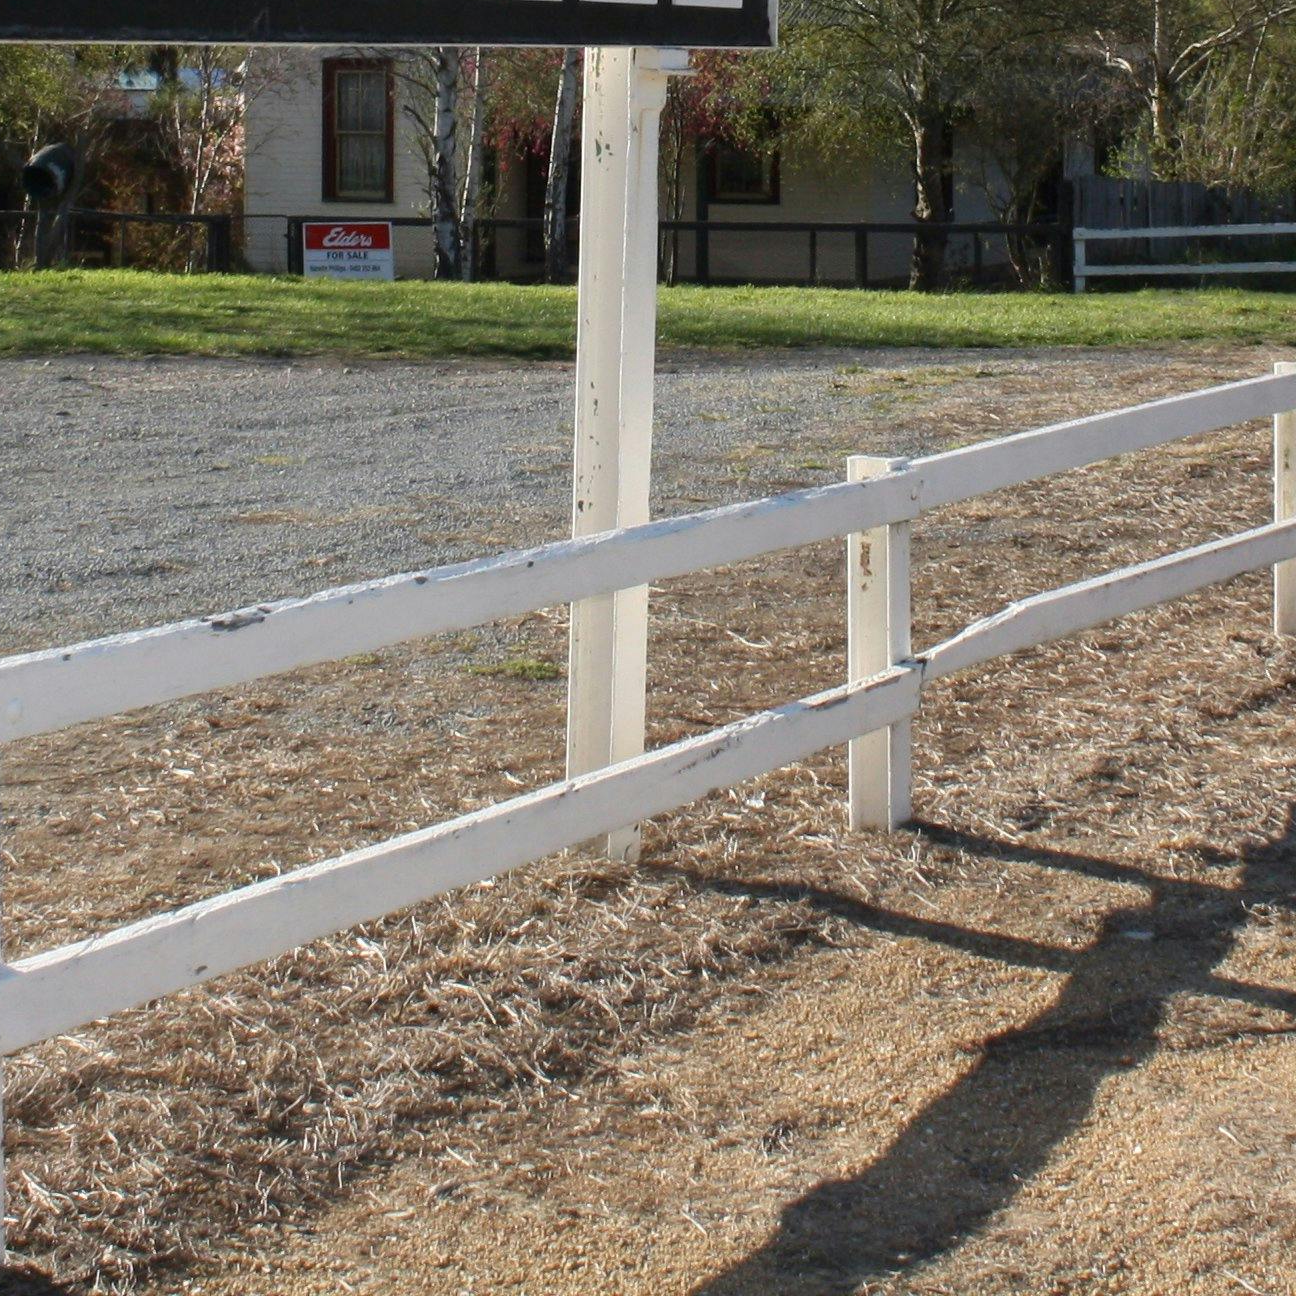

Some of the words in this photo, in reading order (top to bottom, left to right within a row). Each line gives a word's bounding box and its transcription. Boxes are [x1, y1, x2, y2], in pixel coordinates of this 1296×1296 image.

[322, 227, 372, 247] Elders
[326, 251, 344, 260] FOR
[347, 251, 369, 260] SALE
